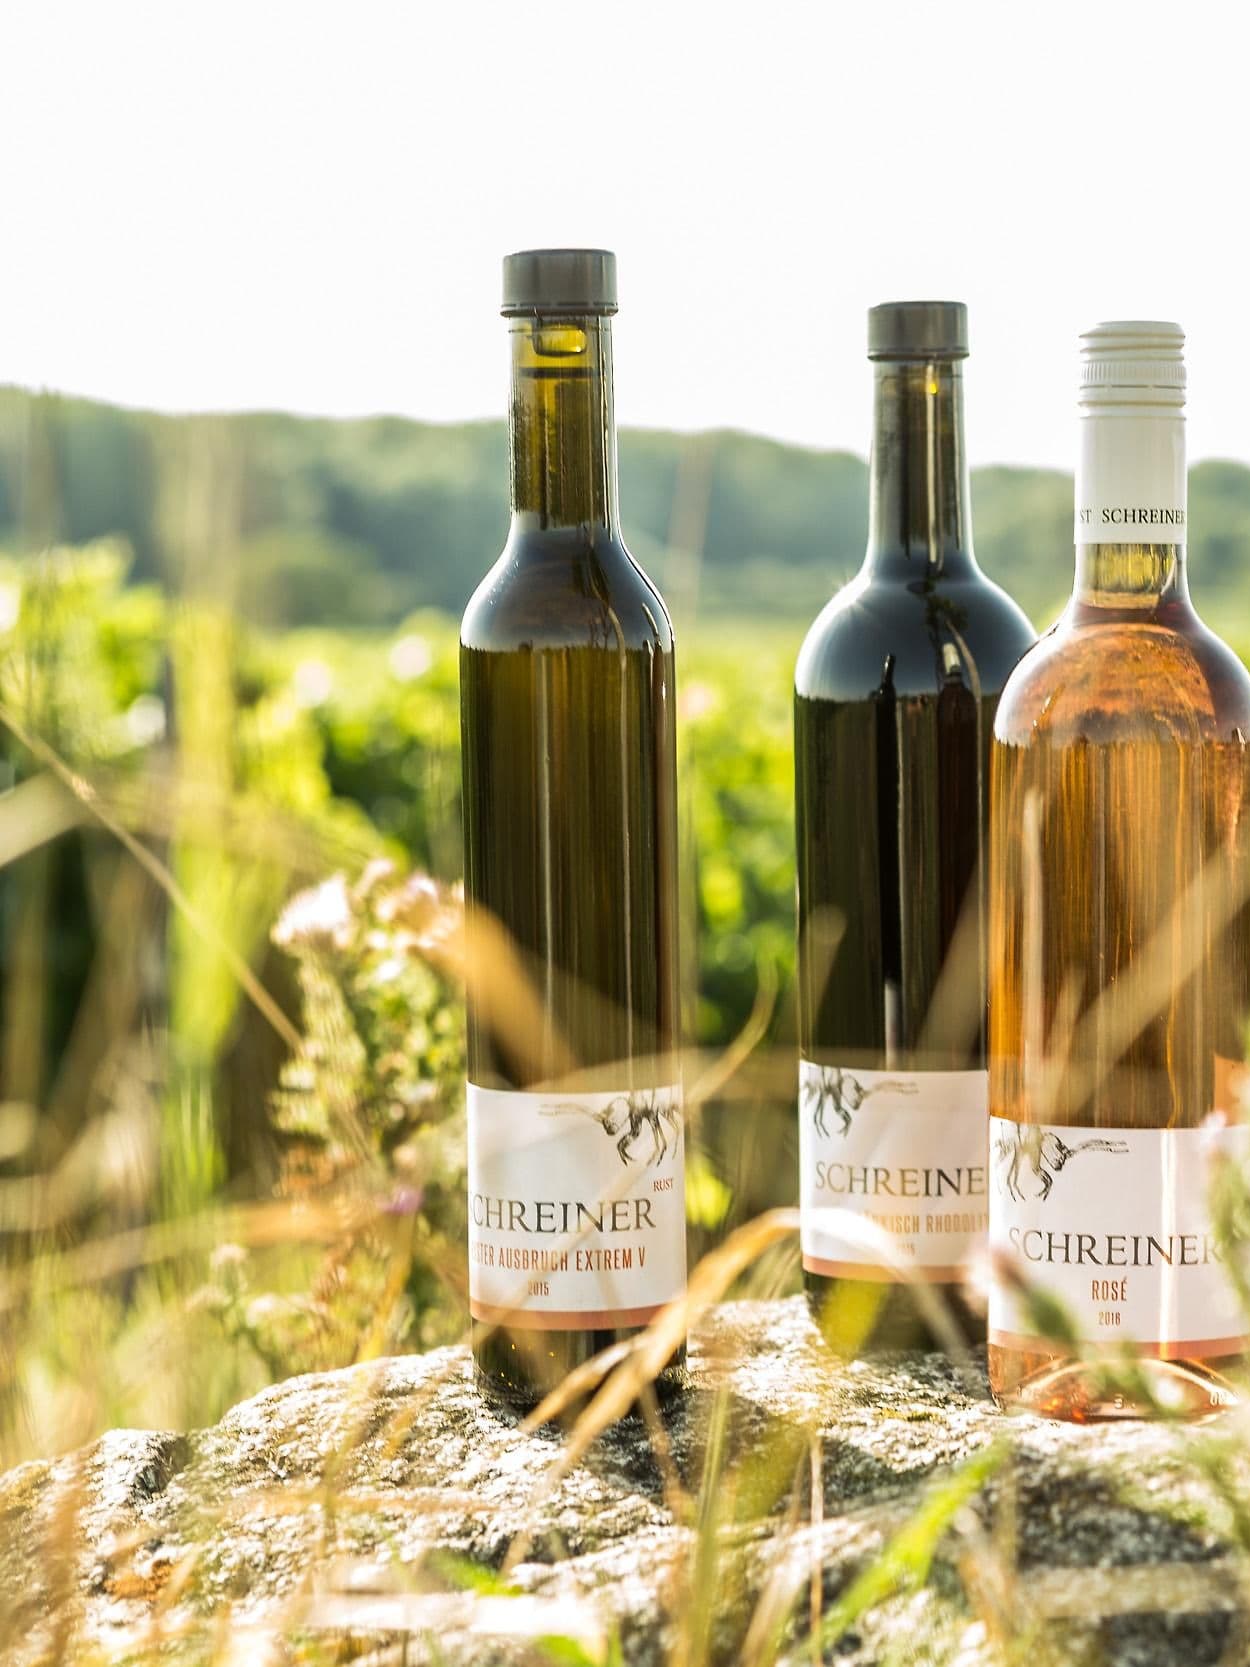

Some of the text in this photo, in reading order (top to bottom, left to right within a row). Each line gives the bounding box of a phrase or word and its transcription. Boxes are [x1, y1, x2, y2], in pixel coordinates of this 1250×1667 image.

[653, 1178, 673, 1192] RUST
[816, 1161, 985, 1197] SCHREINE
[473, 1193, 656, 1233] CHREINER
[499, 1247, 568, 1271] AUSBRUCH
[576, 1249, 632, 1271] EXTREM
[638, 1248, 646, 1268] V
[1092, 1276, 1127, 1301] ROSÉ
